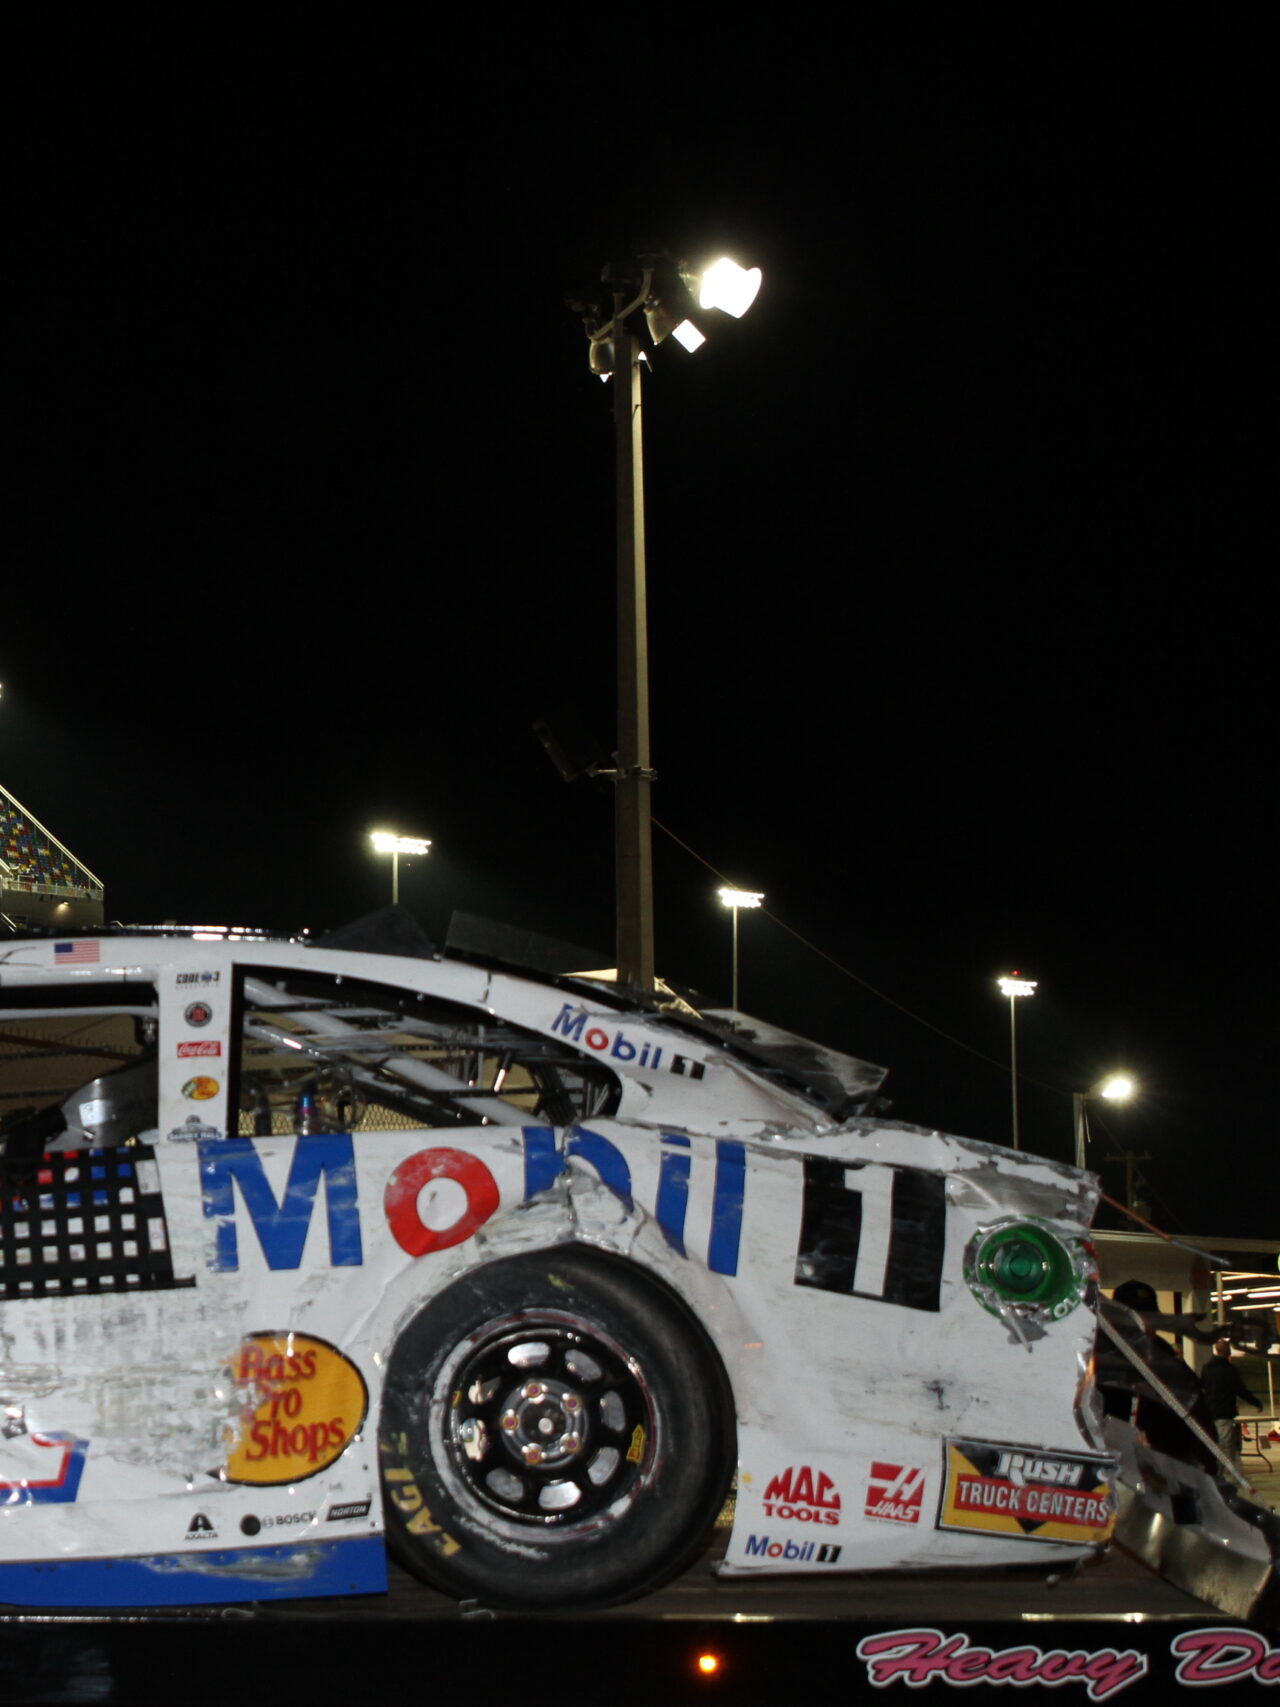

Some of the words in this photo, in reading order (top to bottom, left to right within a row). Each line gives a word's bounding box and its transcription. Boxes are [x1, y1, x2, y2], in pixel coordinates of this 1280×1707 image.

[551, 1002, 663, 1070] Mobil
[197, 1126, 746, 1278] Mobil
[244, 1417, 346, 1463] Shops
[763, 1465, 841, 1510] MAC
[995, 1453, 1084, 1488] RUSH
[330, 1504, 367, 1518] NORTON
[762, 1503, 840, 1526] TOOLS
[873, 1500, 918, 1520] HAAS
[958, 1480, 1021, 1511] TRUCK
[1026, 1489, 1110, 1524] CENTERS
[746, 1533, 814, 1561] Mobil
[855, 1627, 1149, 1702] Heavy
